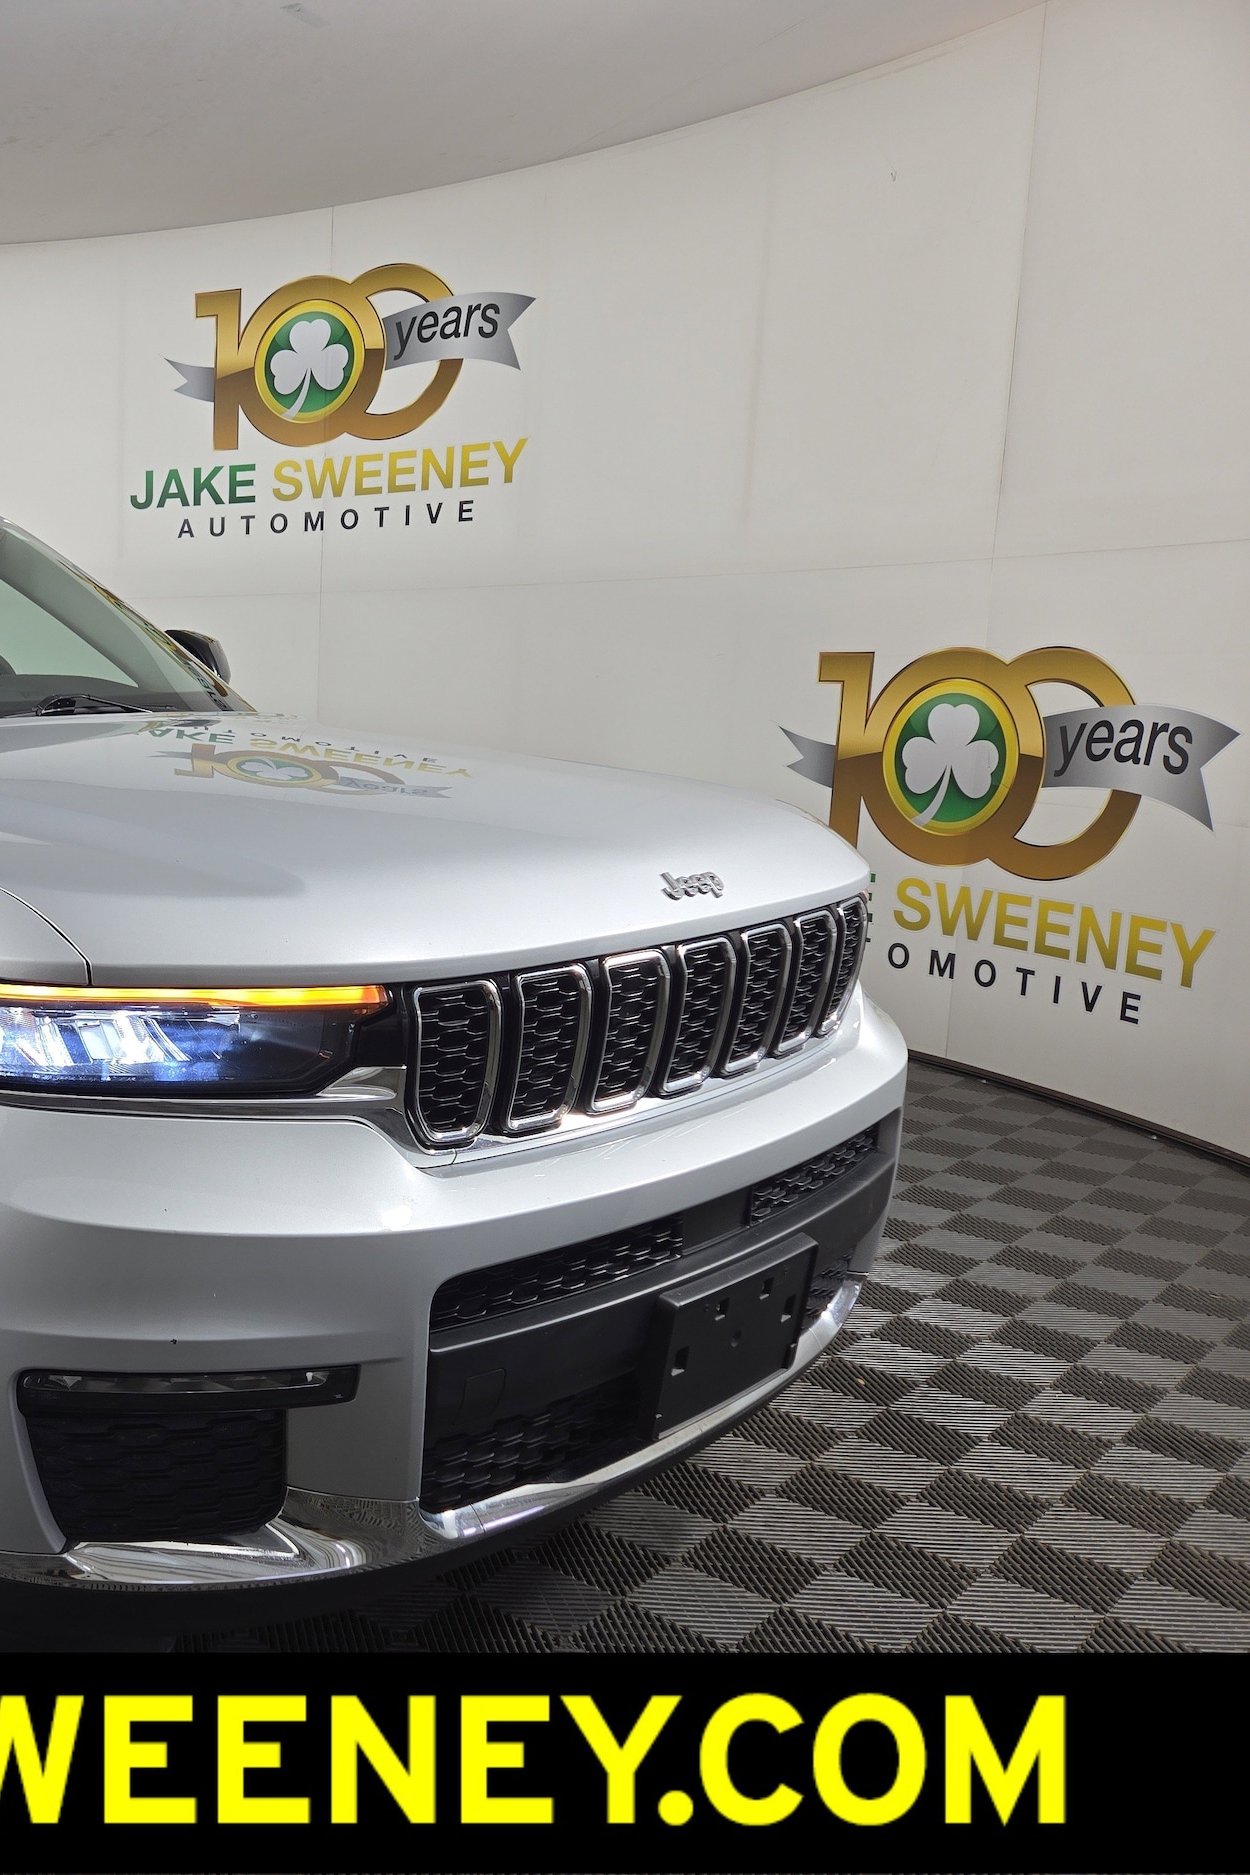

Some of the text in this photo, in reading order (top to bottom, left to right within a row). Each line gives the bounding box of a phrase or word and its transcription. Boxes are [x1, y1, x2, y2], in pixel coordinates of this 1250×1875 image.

[393, 301, 501, 361] years
[130, 438, 528, 510] JAKE SWEENEY
[177, 500, 475, 539] AUTOMOTIVE
[1053, 719, 1193, 777] years
[660, 872, 724, 900] Jeep
[893, 877, 1217, 989] SWEENEY
[866, 938, 1142, 1025] OMOTIVE
